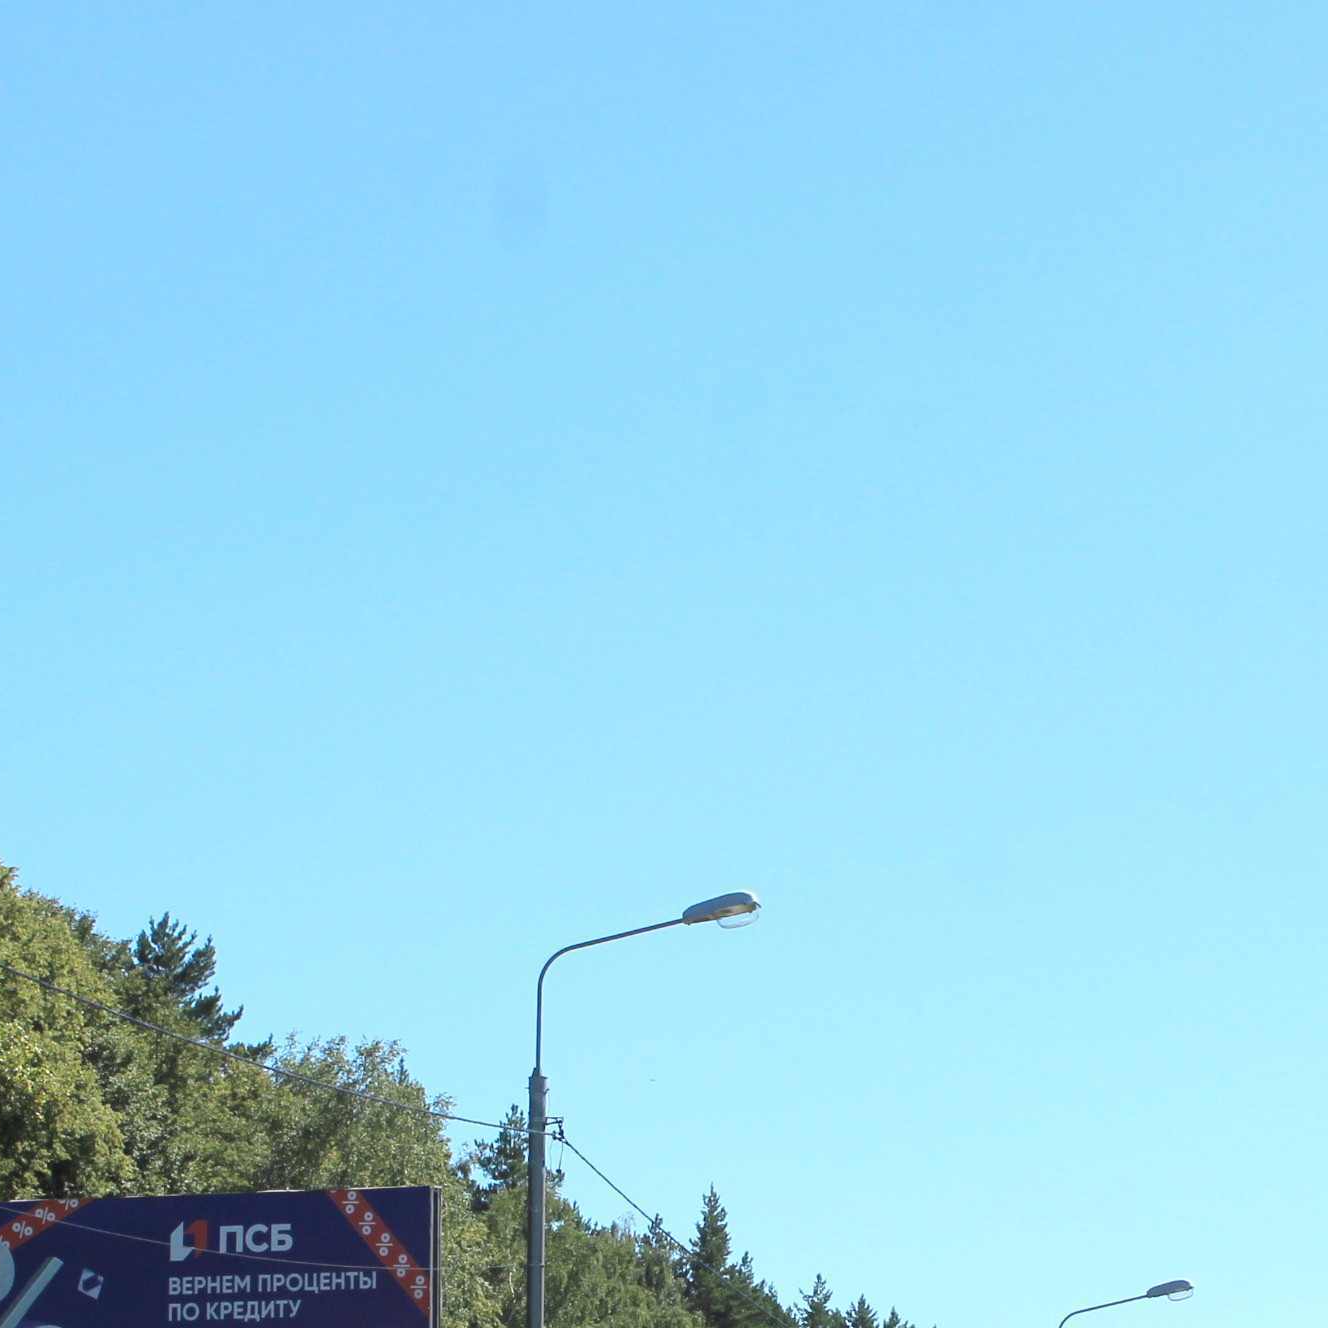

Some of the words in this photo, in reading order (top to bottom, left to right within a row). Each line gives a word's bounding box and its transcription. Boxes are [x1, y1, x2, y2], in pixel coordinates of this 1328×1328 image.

[219, 1223, 294, 1254] ПСБ
[168, 1275, 251, 1296] ВЕРНЕМ
[258, 1271, 377, 1294] ПРОЦЕНТЫ
[168, 1302, 200, 1322] ПО
[206, 1299, 302, 1323] КРЕДИТУ
